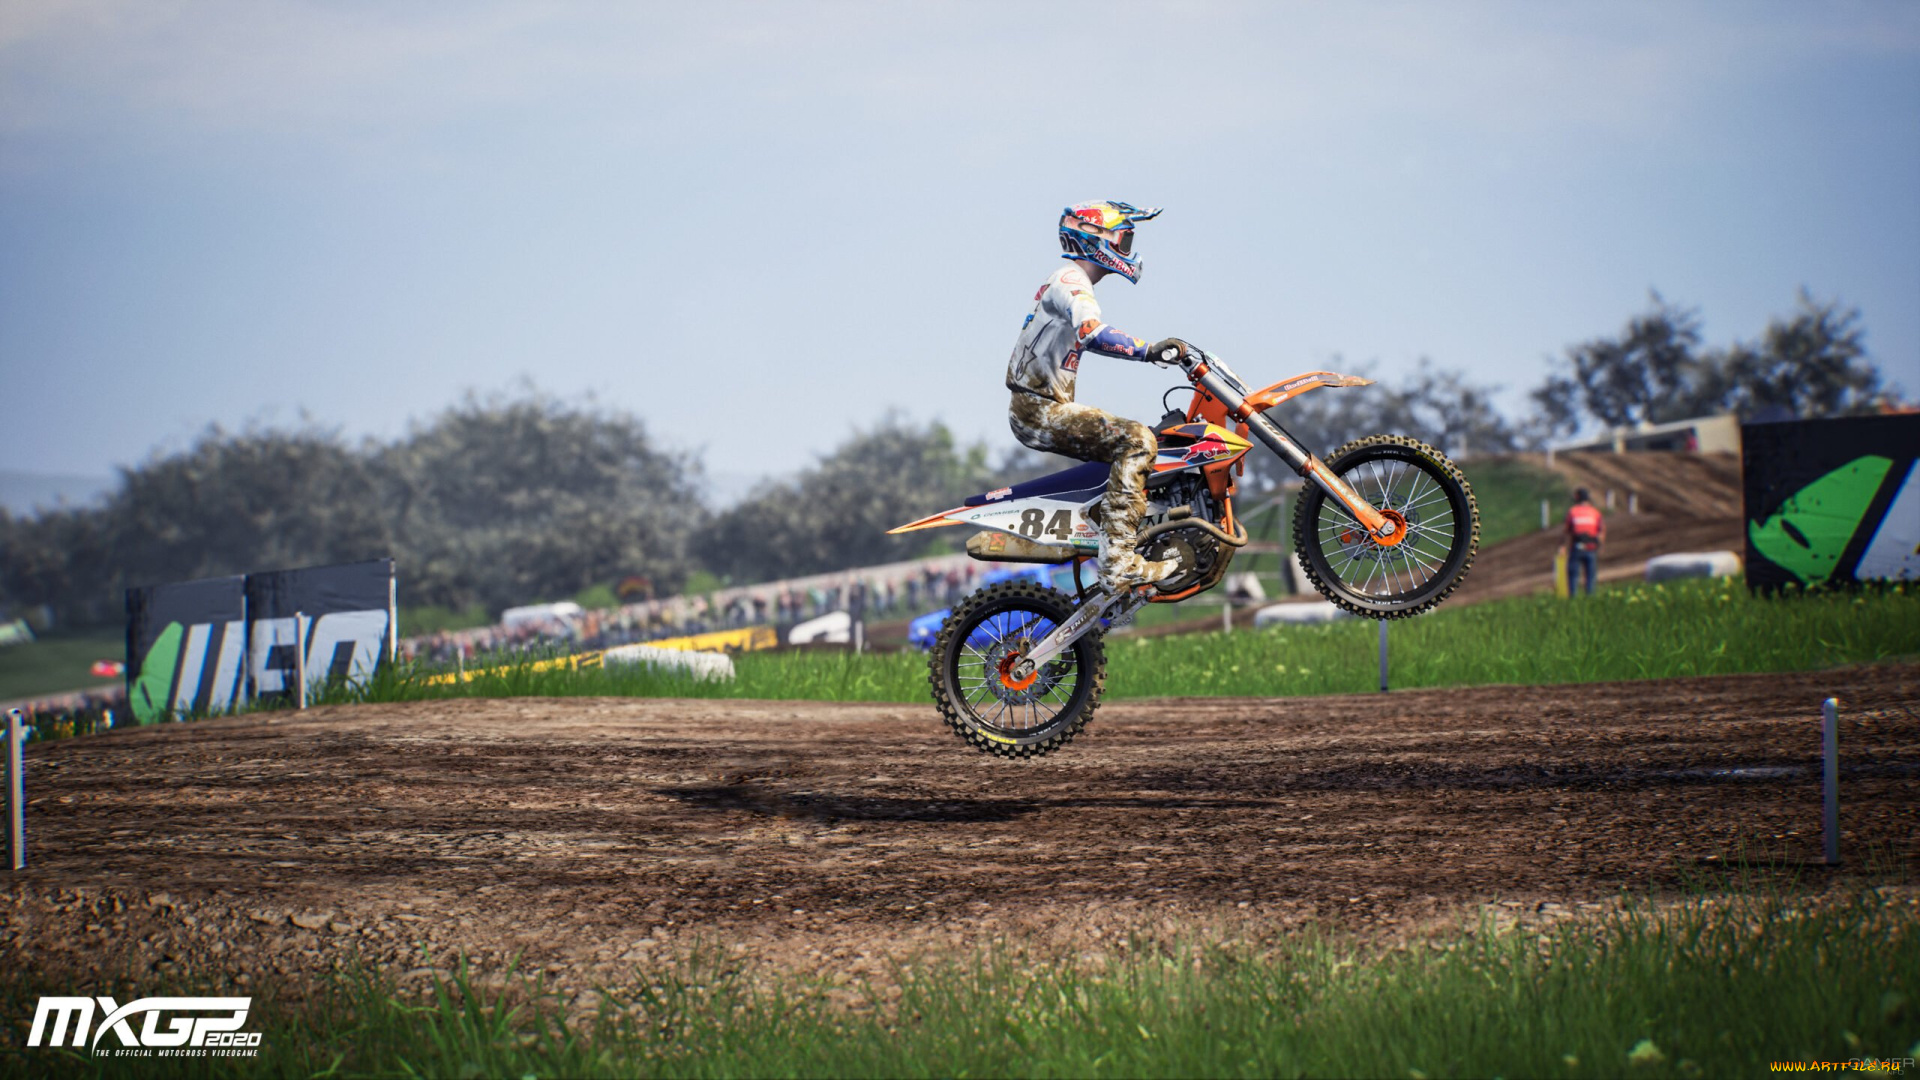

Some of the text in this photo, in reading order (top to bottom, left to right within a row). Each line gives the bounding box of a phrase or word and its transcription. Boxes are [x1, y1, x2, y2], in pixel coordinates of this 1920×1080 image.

[1095, 249, 1116, 267] Red
[1114, 258, 1135, 277] Bull
[1102, 342, 1134, 356] Red Bull
[1019, 508, 1073, 541] 84
